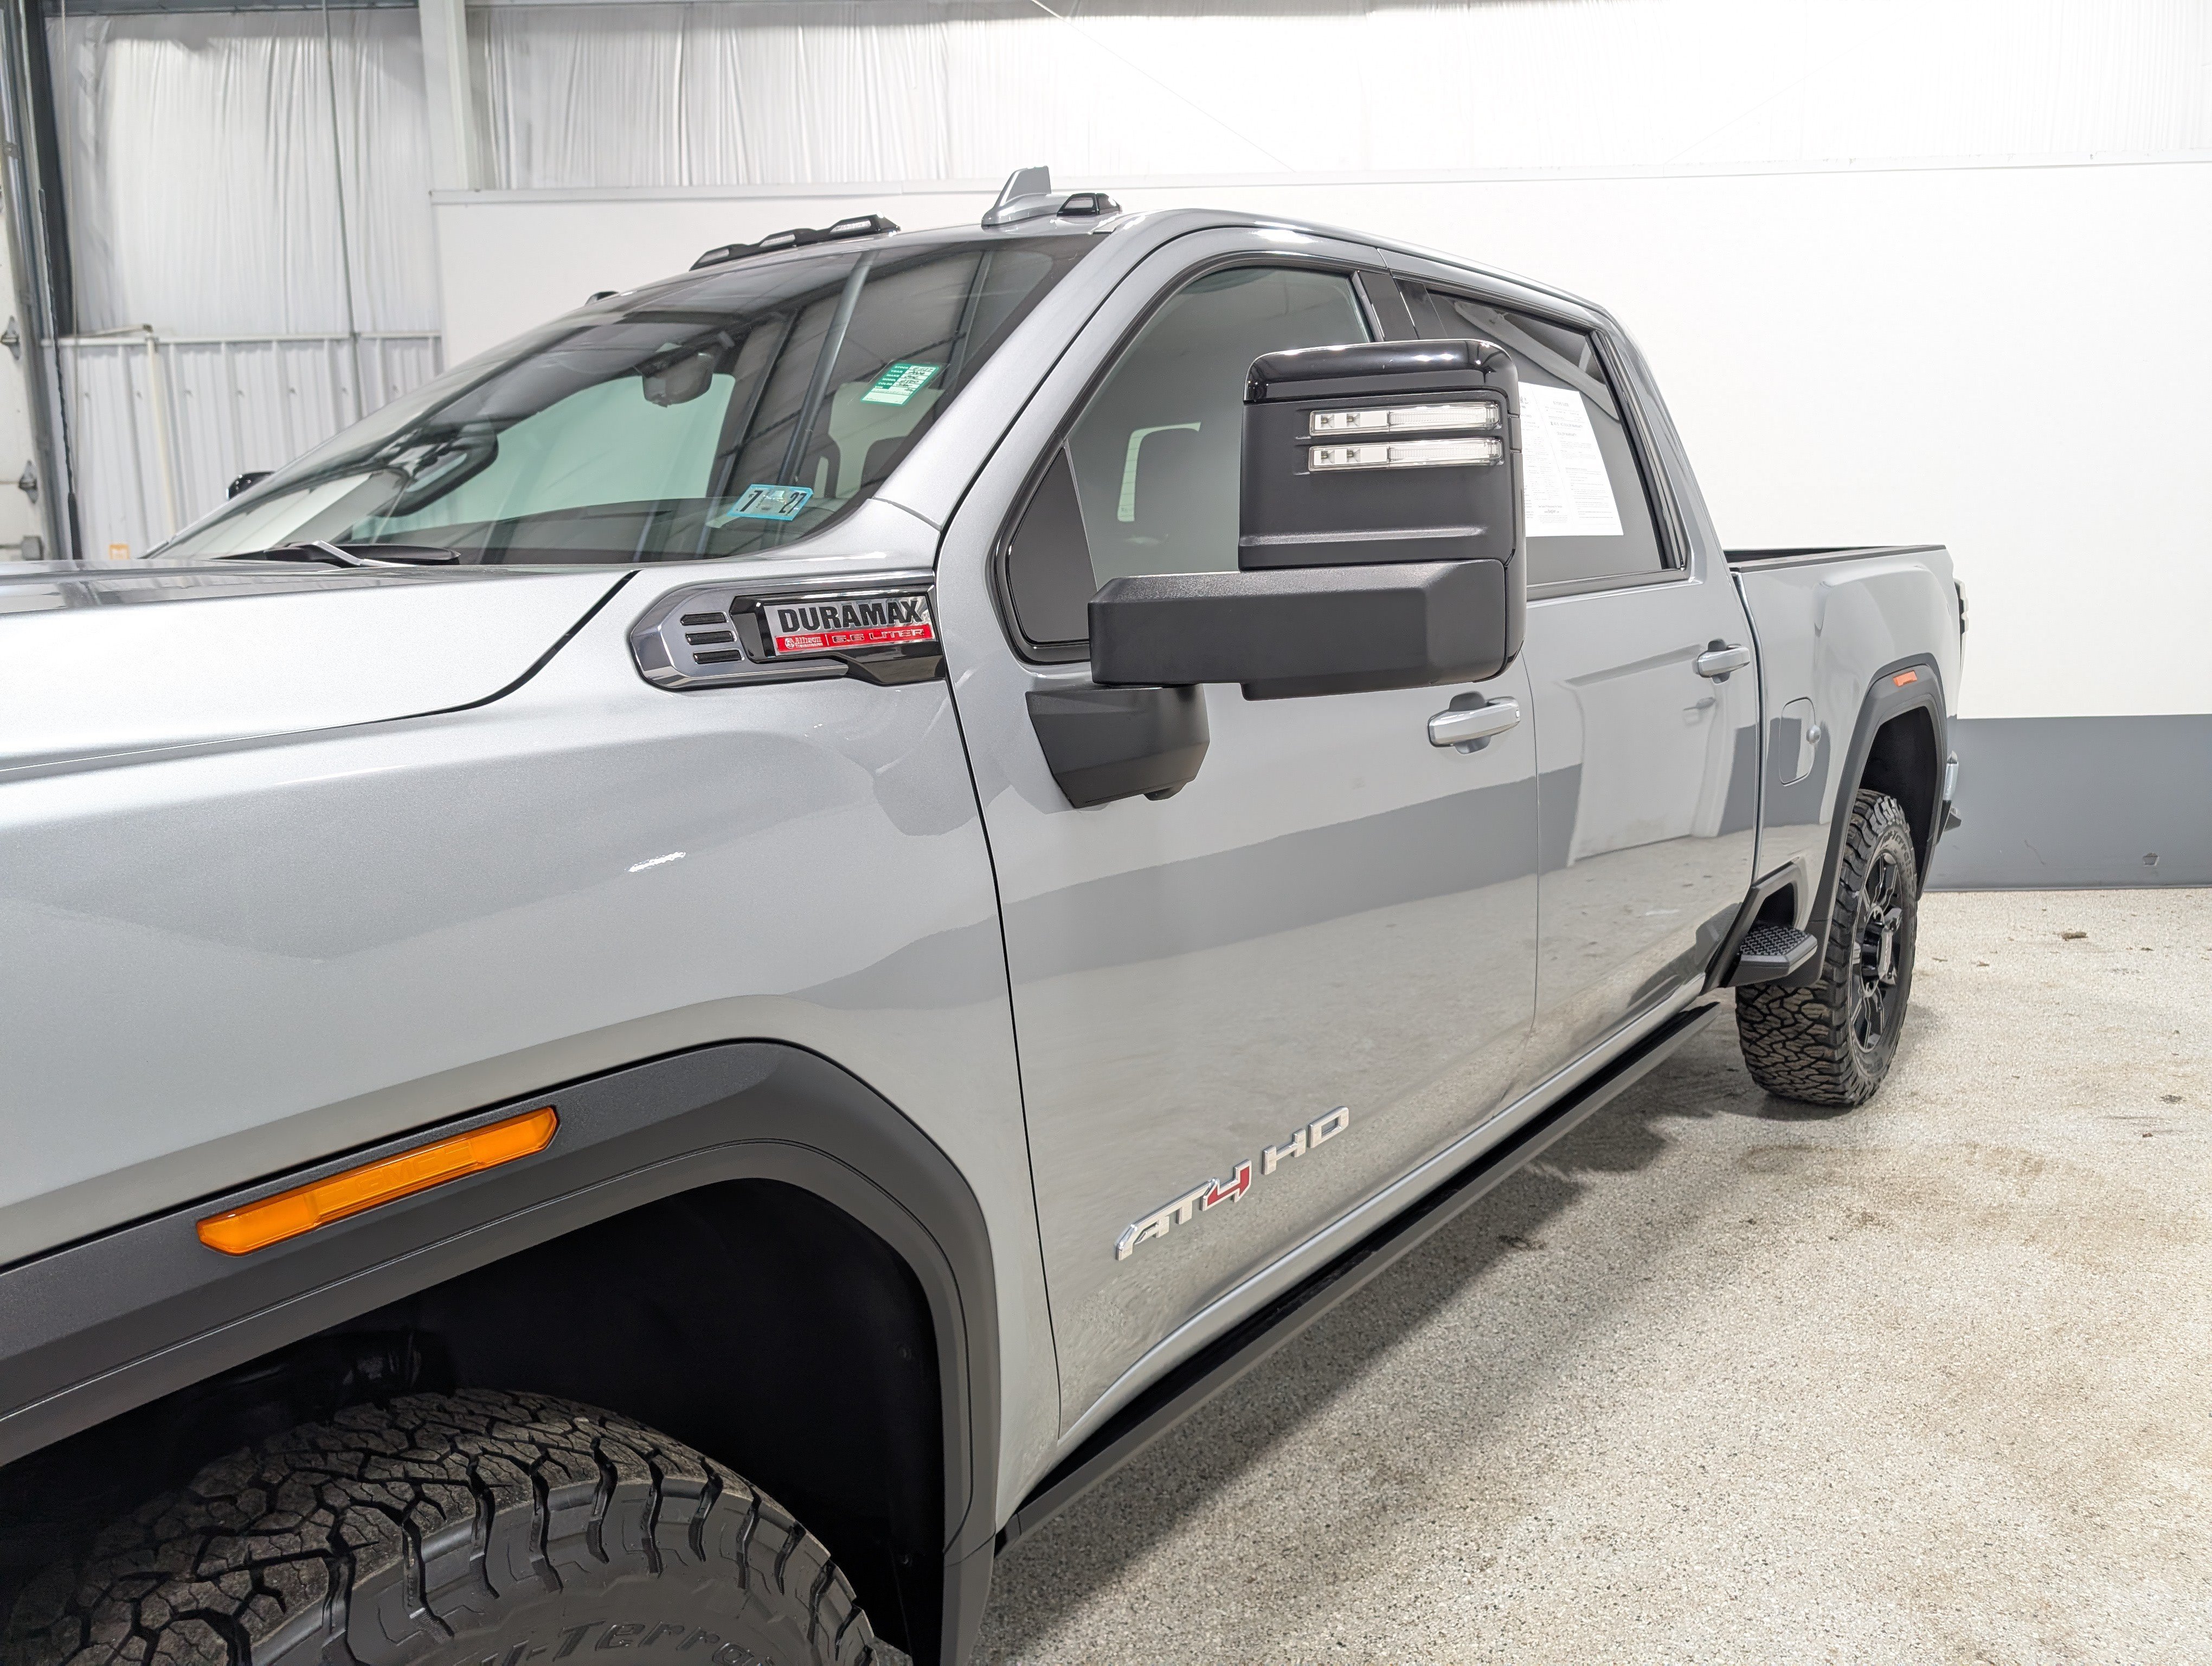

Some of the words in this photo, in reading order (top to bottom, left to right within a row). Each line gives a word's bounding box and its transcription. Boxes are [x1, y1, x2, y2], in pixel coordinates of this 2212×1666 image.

[740, 490, 764, 512] 7
[779, 492, 807, 514] 27
[777, 600, 922, 633] DURAMAX
[832, 633, 865, 643] 6.6
[869, 628, 924, 640] LITER
[355, 1151, 440, 1196] GMC
[1114, 1158, 1252, 1261] AT4
[1261, 1105, 1349, 1176] HD
